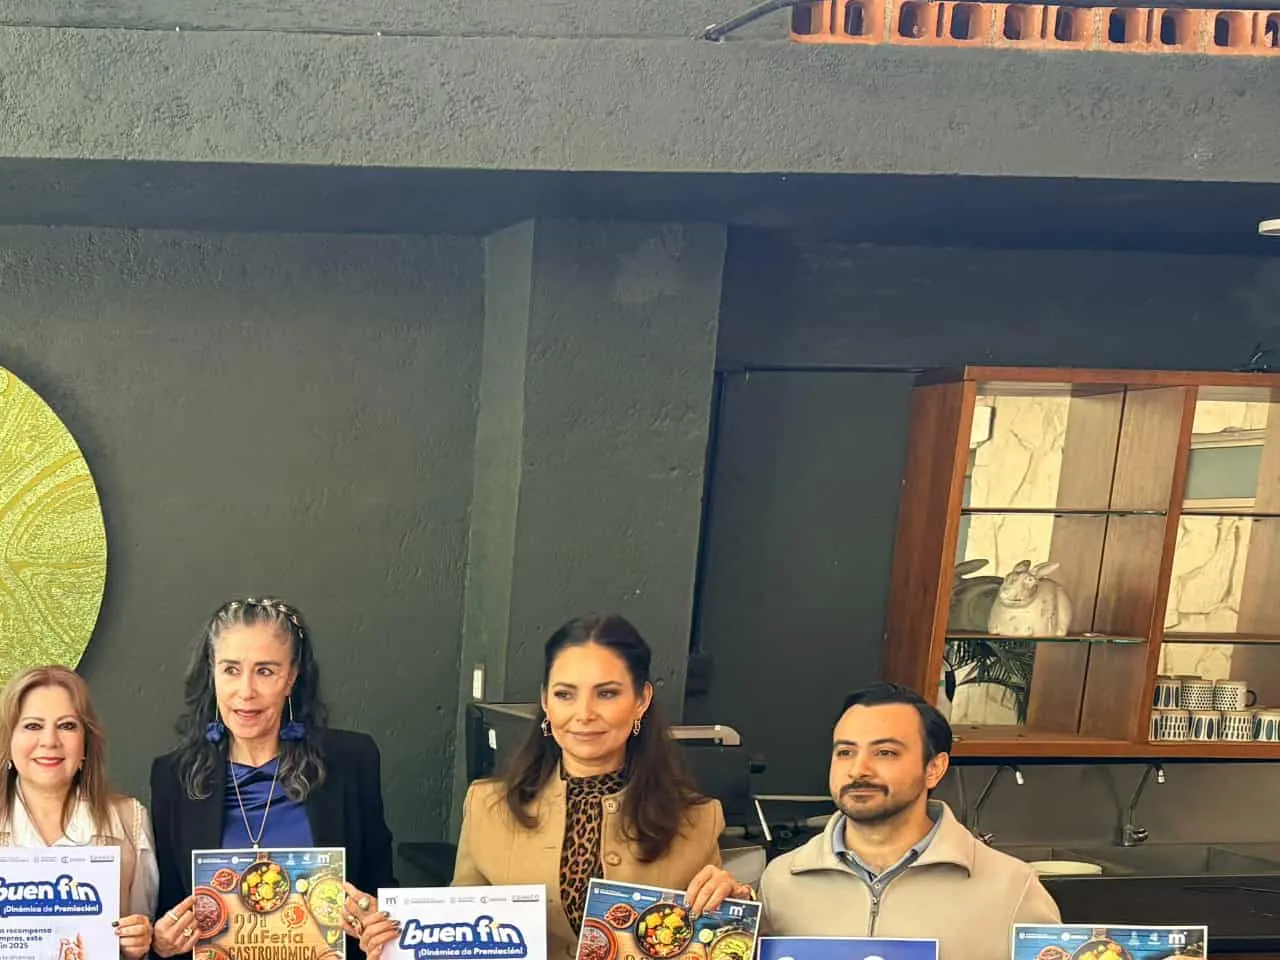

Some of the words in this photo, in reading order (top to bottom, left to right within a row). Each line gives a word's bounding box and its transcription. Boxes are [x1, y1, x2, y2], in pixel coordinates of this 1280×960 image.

[57, 876, 96, 901] fin
[43, 905, 53, 913] de
[260, 929, 304, 944] Feria
[404, 922, 473, 945] buen
[477, 919, 520, 943] fin
[229, 944, 317, 960] GASTRONÓMICA
